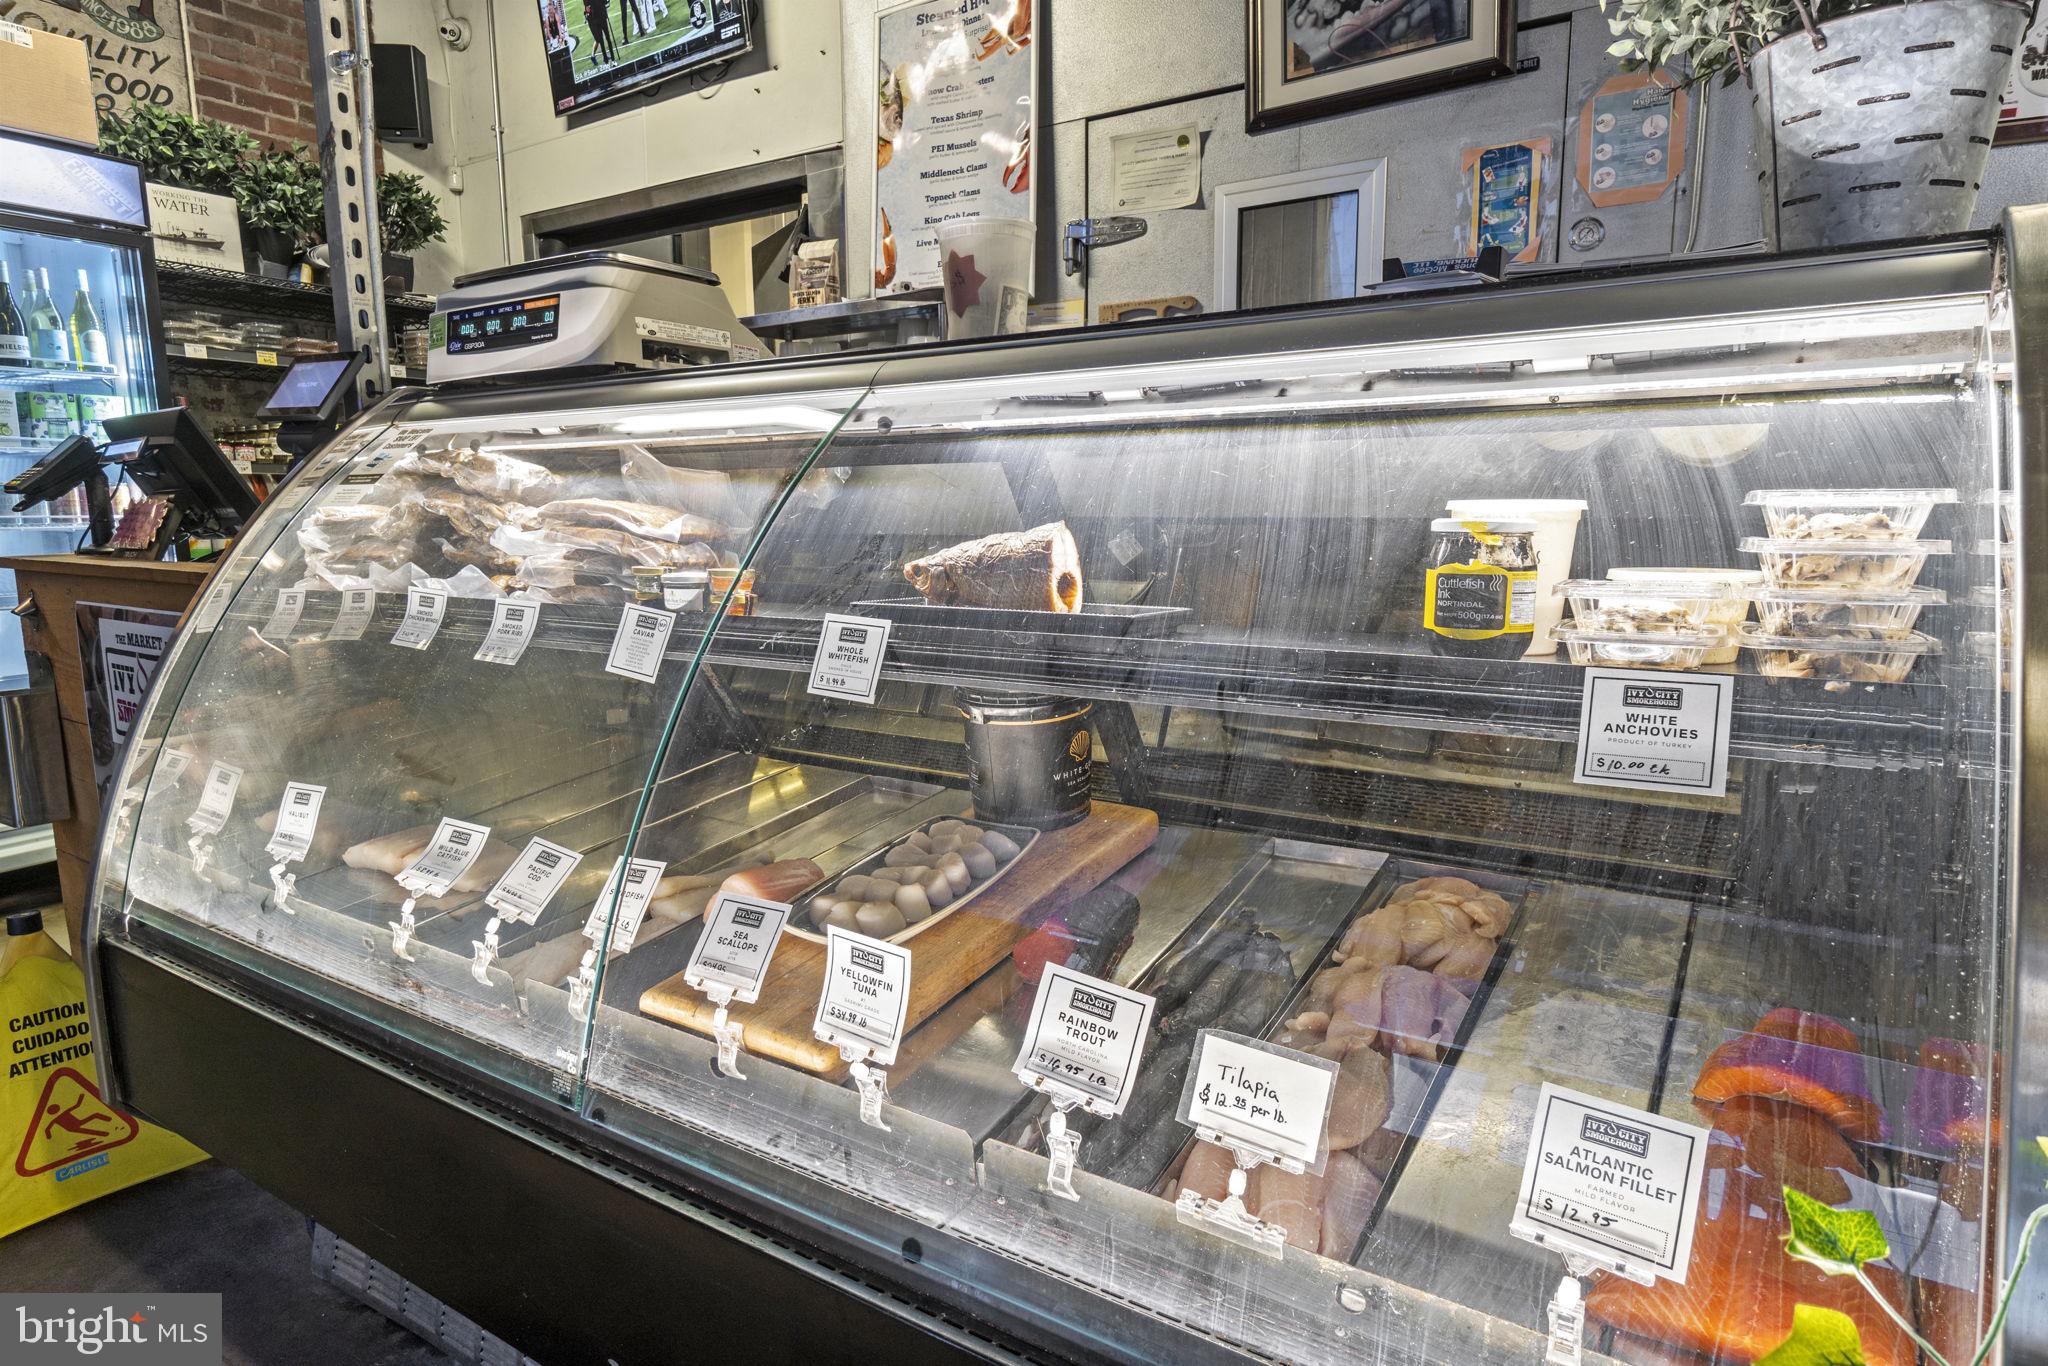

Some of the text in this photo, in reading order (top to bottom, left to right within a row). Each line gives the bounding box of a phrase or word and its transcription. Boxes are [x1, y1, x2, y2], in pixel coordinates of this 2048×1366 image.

[107, 15, 157, 39] 1988
[721, 23, 741, 39] ESPN
[931, 115, 955, 124] Texas
[955, 109, 983, 121] Shrimp
[931, 139, 977, 153] PEI Mussels
[920, 168, 964, 180] Middleneck
[966, 162, 988, 174] Clams
[924, 192, 956, 204] Topneck
[957, 188, 980, 198] Clams
[153, 197, 210, 216] WATER
[916, 239, 932, 247] Live
[1438, 577, 1485, 590] Cuttlefish
[1438, 590, 1451, 599] Ink
[1438, 600, 1485, 608] NORTINDAL
[1458, 611, 1480, 621] 500g
[502, 623, 523, 631] SMOKED
[633, 628, 655, 638] CAVIAR
[115, 632, 163, 650] THE MARKET
[828, 652, 869, 664] WHITEFISH
[837, 645, 864, 655] WHOLE
[112, 670, 135, 695] IVY
[1626, 697, 1679, 707] SMOKEHOUSE
[1627, 689, 1680, 700] IVY CITY
[1626, 713, 1678, 726] WHITE
[1604, 723, 1698, 740] ANCHOVIES
[1607, 737, 1645, 745] PRODUCT
[1662, 742, 1693, 750] TURKEY
[288, 811, 309, 819] HALIBUT
[437, 851, 463, 862] CATFISH
[438, 844, 470, 857] WILD BLUE
[527, 864, 552, 878] PACIFIC
[527, 873, 541, 882] COD
[609, 888, 645, 900] SDFISH
[733, 930, 749, 940] SEA
[717, 936, 759, 953] SCALLOPS
[841, 966, 893, 992] YELLOWFIN
[853, 981, 878, 997] TUNA
[1072, 1000, 1112, 1019] SMOKEHOUSE
[1074, 992, 1114, 1011] IVY CITY
[9, 1002, 86, 1032] CAUTION
[1058, 1011, 1119, 1040] RAINBOW
[12, 1021, 90, 1054] CUIDADO
[1066, 1026, 1106, 1048] TROUT
[1057, 1037, 1108, 1060] NORTH CAROLINA
[1061, 1046, 1101, 1064] MILD FLAVOR
[1218, 1064, 1280, 1102] Tilapia
[1250, 1104, 1271, 1118] per
[1273, 1108, 1288, 1124] lb.
[1585, 1119, 1648, 1145] IVY CITY
[1585, 1129, 1645, 1154] SMOKEHOUSE
[59, 1152, 110, 1179] CARLISLE
[1569, 1145, 1654, 1181] ATLANTIC
[1544, 1152, 1678, 1204] SALMON FILLET
[1587, 1183, 1625, 1201] FARMED
[1574, 1187, 1636, 1214] MILD FLAVOR
